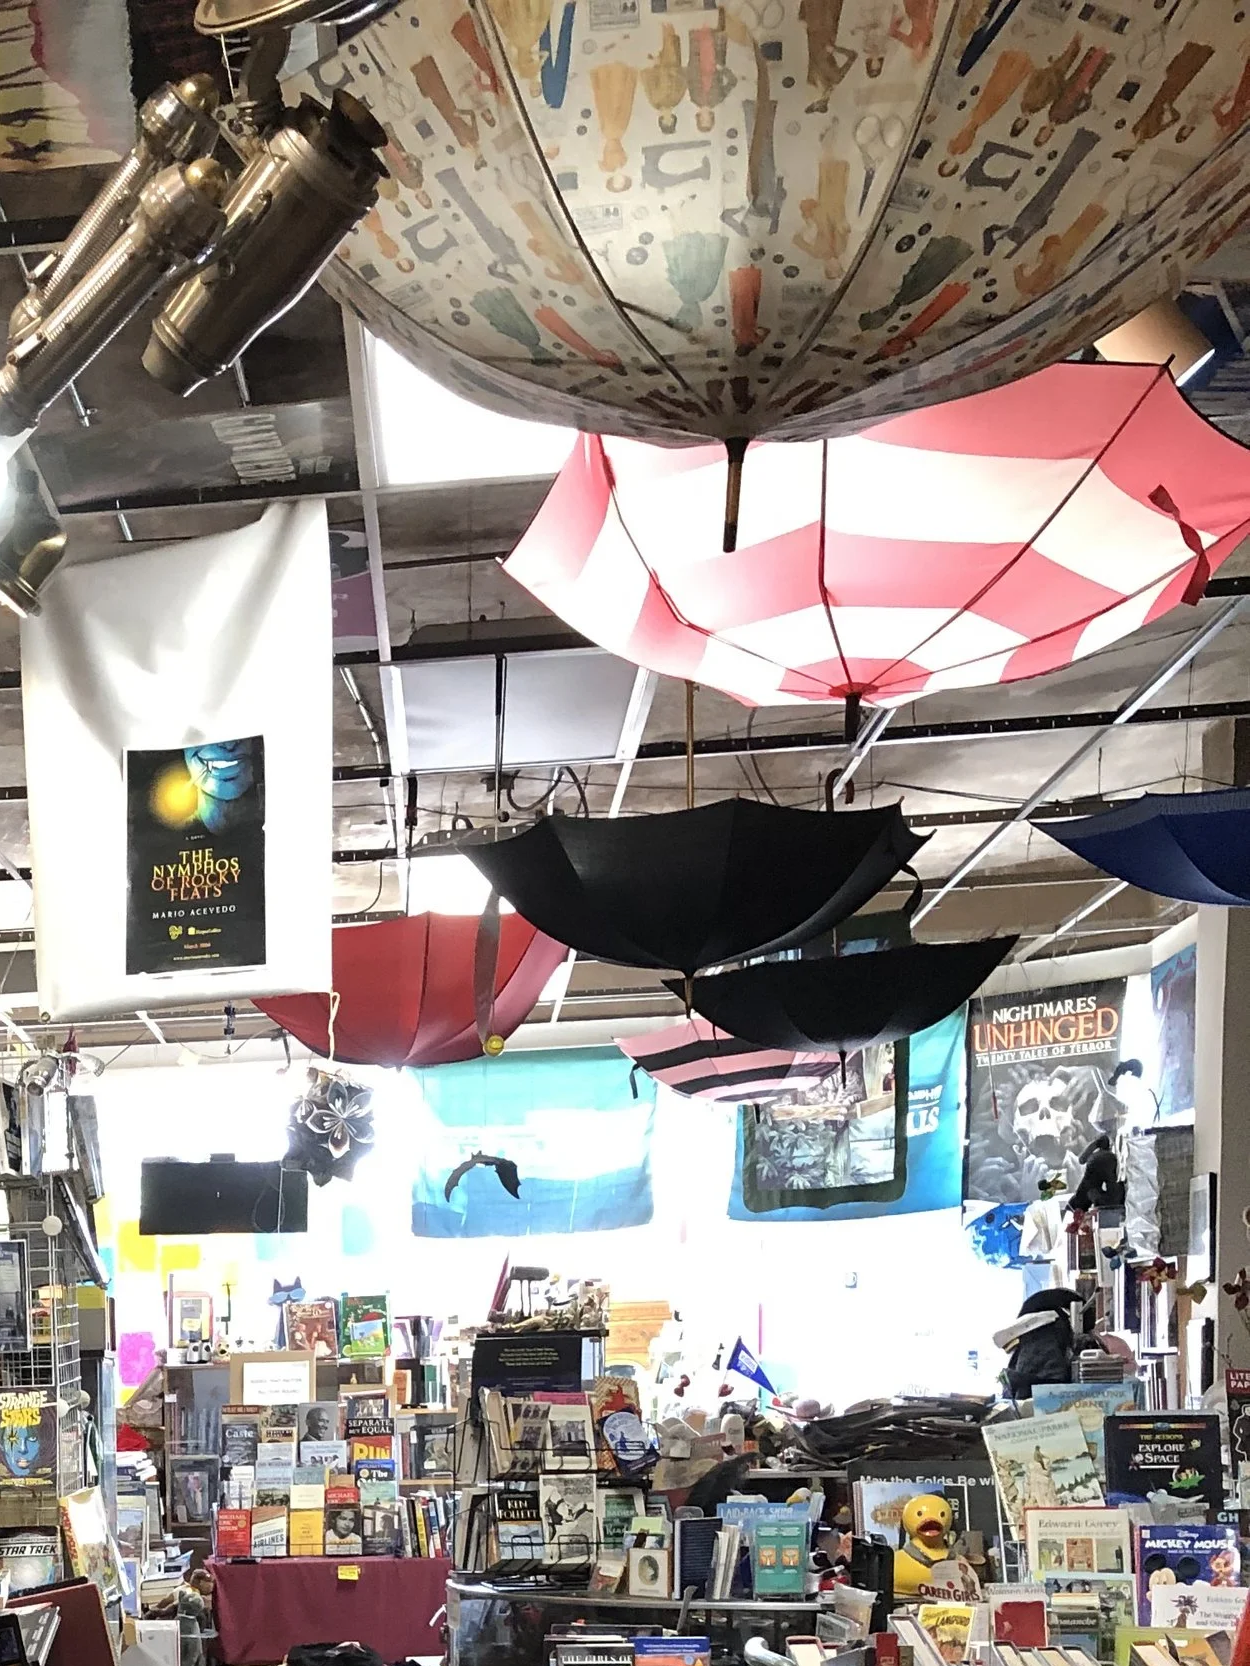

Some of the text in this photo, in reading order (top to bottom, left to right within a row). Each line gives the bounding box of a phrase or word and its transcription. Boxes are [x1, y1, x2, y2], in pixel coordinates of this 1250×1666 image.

[179, 848, 213, 864] THE
[153, 858, 239, 879] NYMPHOS
[152, 869, 241, 891] OF ROCKY
[171, 884, 222, 901] FLATS
[152, 905, 236, 919] MARIO ACEVEDO
[992, 996, 1097, 1024] NIGHTMARES
[973, 1008, 1118, 1052] UNHINGED
[976, 1041, 1112, 1065] TWENTY TALES OF TERROR
[0, 1408, 42, 1428] STARS
[348, 1418, 392, 1427] SEPARATE
[225, 1427, 254, 1439] Caste
[361, 1425, 392, 1434] EQUAL
[1138, 1443, 1186, 1453] EXPLORE
[1144, 1453, 1181, 1464] SPACE
[370, 1470, 388, 1481] The
[956, 1475, 978, 1486] Be
[507, 1499, 530, 1511] KEN
[1037, 1518, 1079, 1530] Edward
[253, 1534, 284, 1548] AIRLINES
[1144, 1538, 1235, 1550] MICKEY MOUSE
[27, 1543, 58, 1555] TREK
